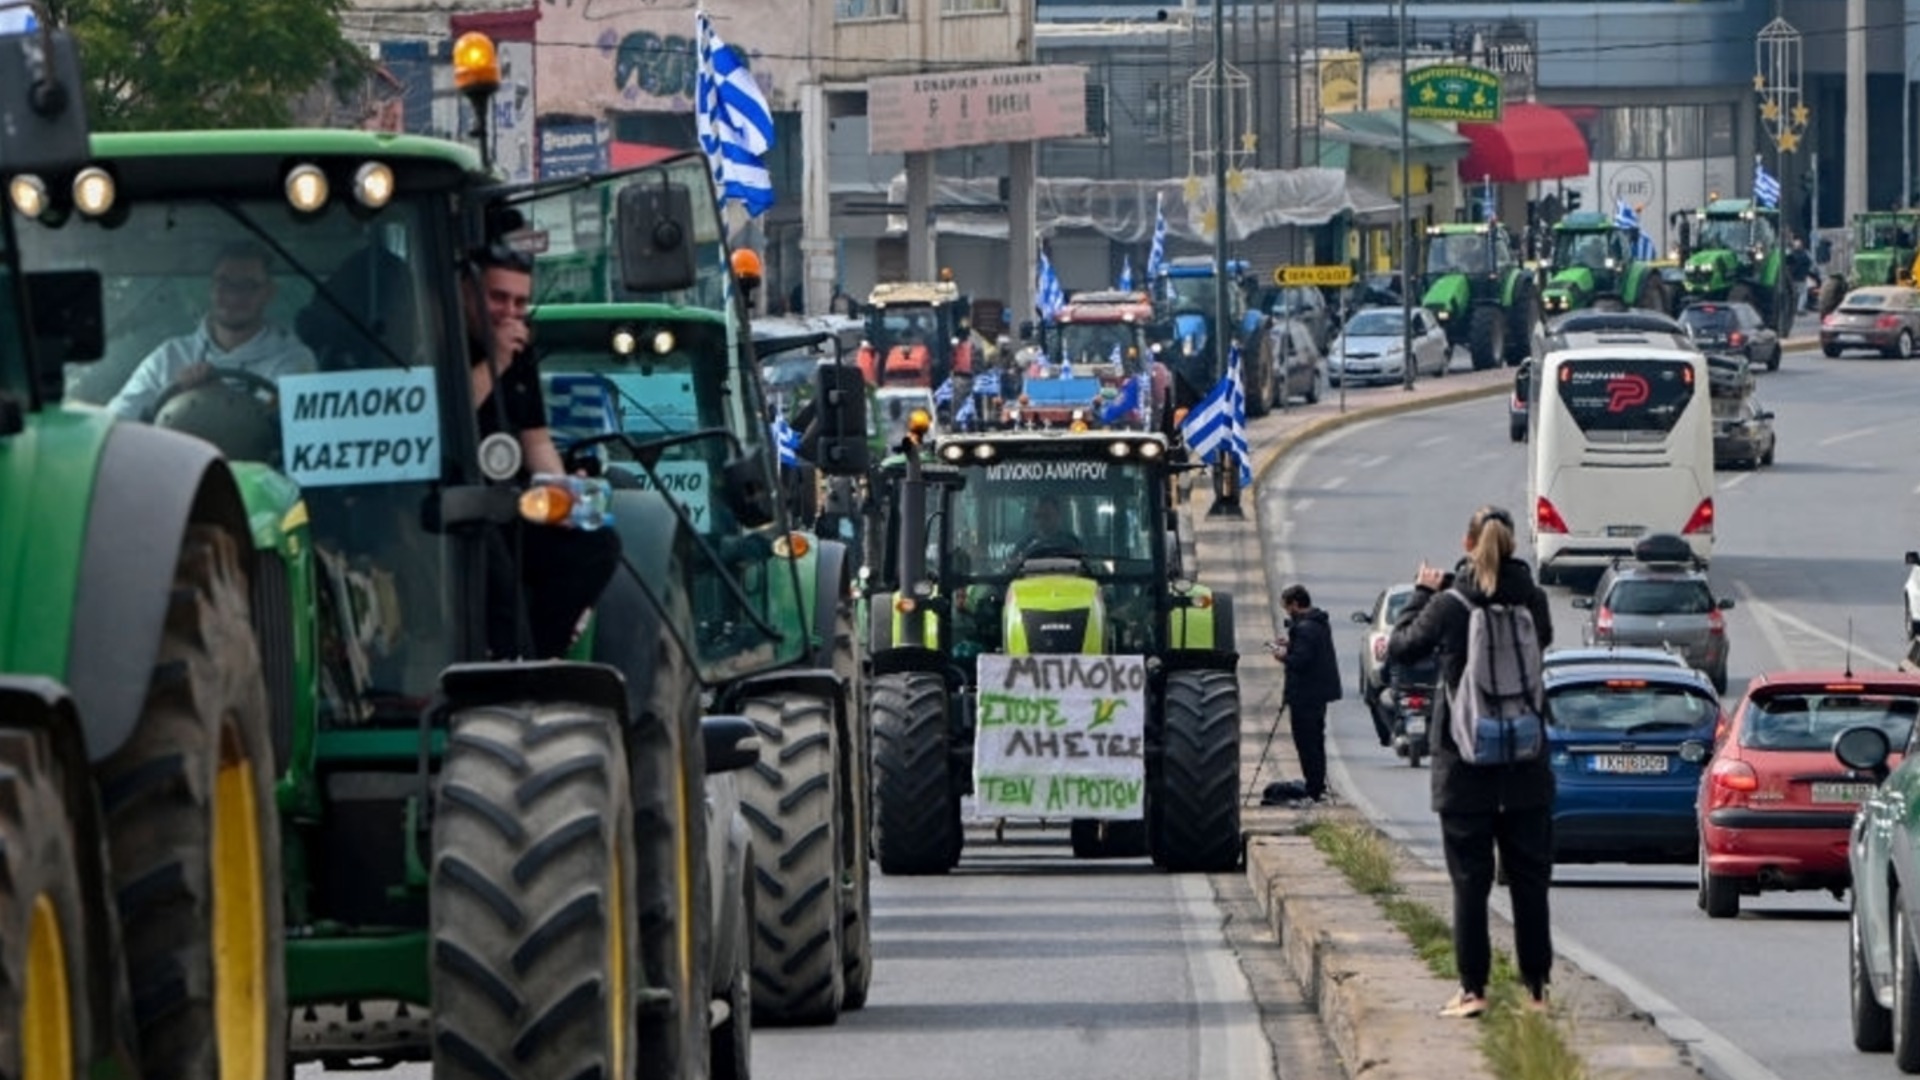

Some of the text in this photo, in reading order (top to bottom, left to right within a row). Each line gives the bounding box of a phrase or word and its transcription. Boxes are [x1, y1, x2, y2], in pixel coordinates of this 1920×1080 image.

[913, 76, 978, 92] ΧΟΝΔΡΙΚΗ
[293, 385, 427, 421] ΜΠΛΟΚΟ
[292, 436, 434, 472] ΚΑΣΤΡΟΥ
[986, 462, 1108, 481] ΜΠΛΟΚΟ ΑΛΜΥΡΟΥ
[1003, 656, 1146, 694] ΜΠΛΟΚΟ
[980, 693, 1067, 727] ΣΤΟΥΣ
[1004, 729, 1143, 759] ΛΗΣΤΕΣ
[979, 775, 1034, 806] ΤΩΝ
